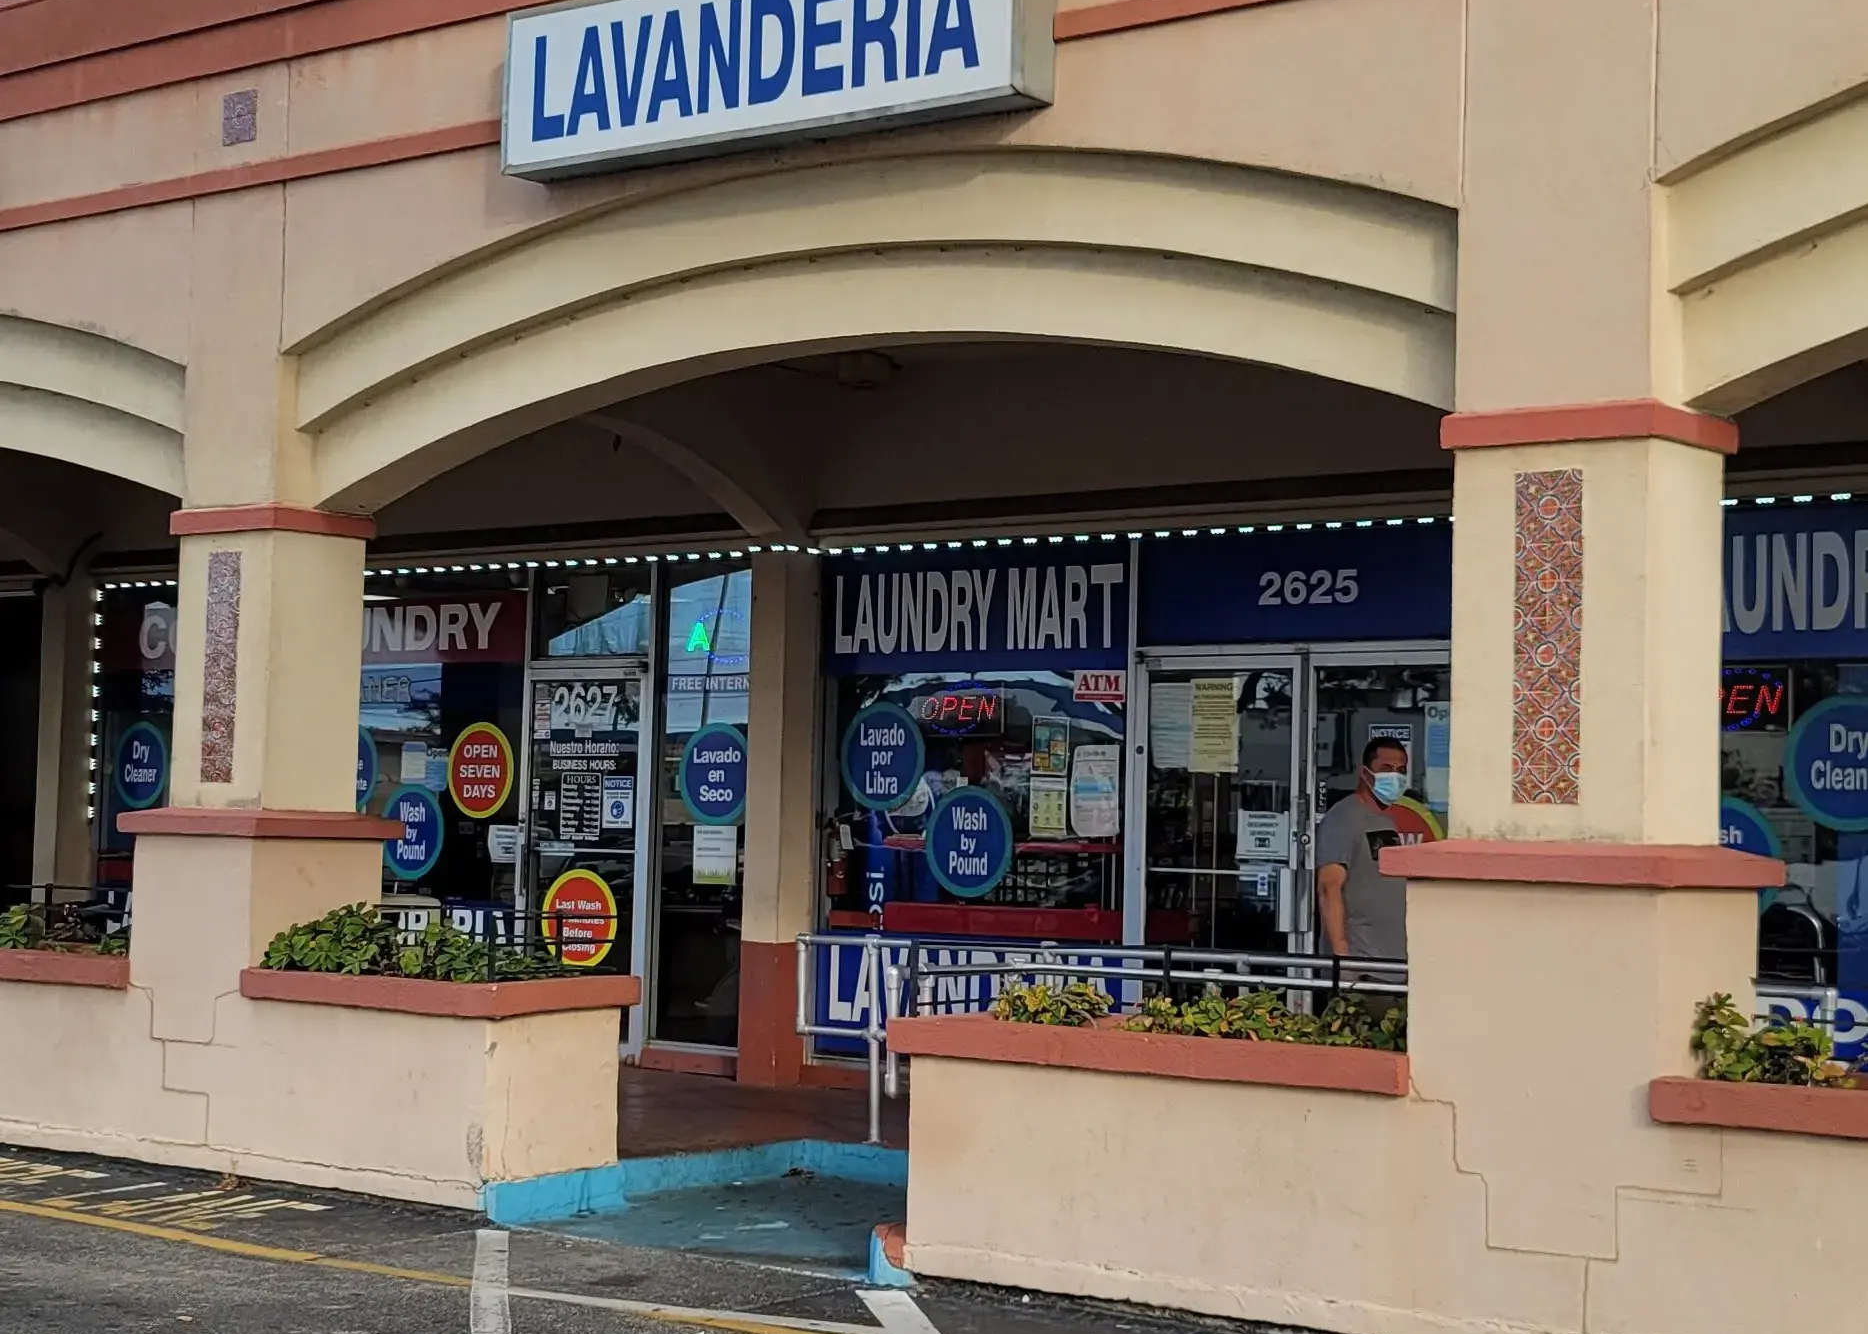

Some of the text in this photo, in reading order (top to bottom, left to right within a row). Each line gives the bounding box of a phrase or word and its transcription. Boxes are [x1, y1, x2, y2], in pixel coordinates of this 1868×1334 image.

[1258, 569, 1359, 605] 2625
[835, 563, 1124, 655] LAUNDRY MART
[672, 677, 705, 691] FREE
[1077, 673, 1121, 692] ATM
[551, 686, 618, 724] 2627
[921, 696, 997, 722] OPEN
[860, 722, 905, 747] Lavado
[1371, 728, 1410, 739] NOTICE
[133, 740, 150, 764] Dry
[463, 744, 498, 758] OPEN
[550, 740, 583, 754] Nuestro
[693, 747, 741, 764] Lavado
[552, 759, 588, 770] BUSINESS
[871, 750, 894, 769] por
[124, 763, 157, 783] Cleaner
[459, 764, 501, 779] SEVEN
[566, 775, 597, 784] HOURS
[708, 769, 725, 782] en
[463, 784, 496, 798] DAYS
[605, 779, 632, 788] NOTICE
[865, 770, 898, 795] Libra
[699, 785, 733, 802] Seco
[399, 801, 426, 823] Wash
[951, 806, 988, 831] Wash
[406, 824, 417, 843] by
[396, 840, 426, 861] Pound
[960, 833, 977, 855] by
[949, 851, 988, 876] Pound
[555, 899, 602, 911] Last Wash
[562, 927, 593, 939] Before
